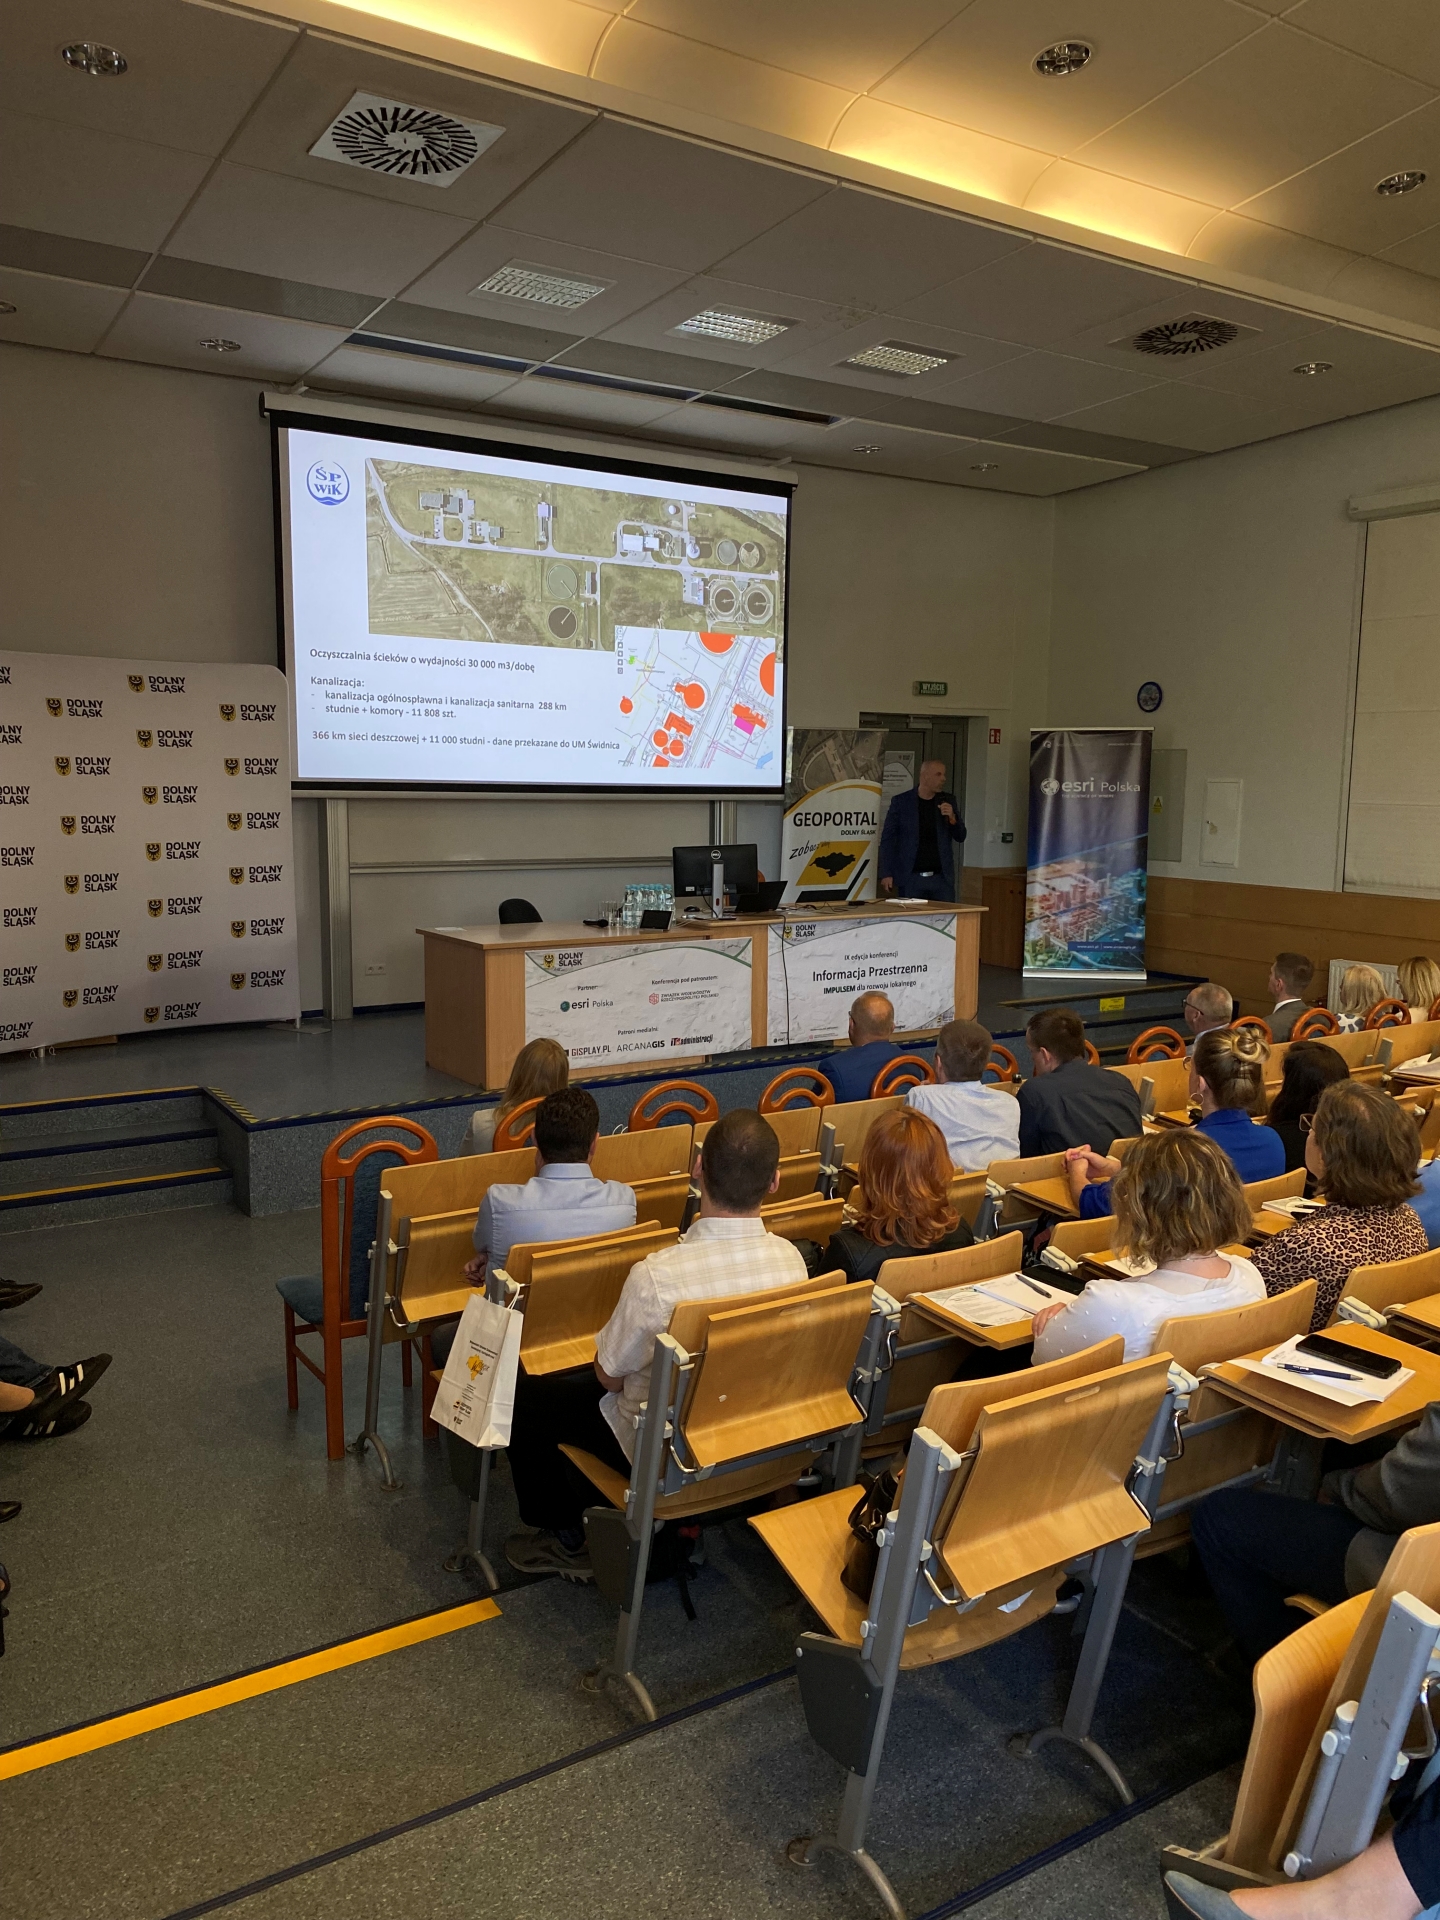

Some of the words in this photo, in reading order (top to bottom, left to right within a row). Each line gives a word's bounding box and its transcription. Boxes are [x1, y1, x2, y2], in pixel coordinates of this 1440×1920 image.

[310, 648, 371, 660] Oczyszczalnia
[374, 652, 408, 662] ścieków
[419, 656, 466, 667] wydajności
[468, 659, 478, 667] 30
[480, 660, 496, 668] 000
[498, 661, 535, 672] m3/dobę
[149, 676, 185, 684] DOLNY
[311, 676, 365, 688] Kanalizacja:
[150, 684, 185, 694] ŚLĄSK
[67, 699, 103, 708] DOLNY
[325, 690, 374, 702] kanalizacja
[378, 692, 442, 705] ogólnospławna
[450, 697, 494, 708] kanalizacja
[497, 700, 534, 709] sanitarna
[538, 702, 552, 710] 288
[555, 702, 566, 710] km
[68, 708, 102, 718] ŚLĄSK
[240, 704, 276, 713] DOLNY
[326, 704, 359, 714] studnie
[370, 706, 404, 718] komory
[424, 708, 440, 717] 808
[442, 710, 456, 718] szt.
[242, 713, 275, 722] ŚLĄSK
[157, 730, 193, 739] DOLNY
[159, 739, 193, 748] ŚLĄSK
[312, 731, 329, 740] 366
[332, 731, 346, 740] km
[348, 732, 368, 741] sieci
[370, 733, 419, 744] deszczowej
[442, 736, 457, 744] 000
[460, 736, 485, 745] studni
[492, 737, 512, 746] dane
[514, 738, 558, 750] przekazane
[560, 740, 570, 748] do
[588, 739, 620, 750] Świdnica
[75, 757, 111, 766] DOLNY
[245, 758, 279, 767] DOLNY
[77, 766, 110, 775] ŚLĄSK
[245, 767, 277, 776] ŚLĄSK
[1062, 777, 1094, 792] esri
[1101, 781, 1140, 792] Polska
[163, 786, 198, 794] DOLNY
[163, 794, 196, 804] ŚLĄSK
[81, 816, 116, 824] DOLNY
[247, 812, 280, 821] DOLNY
[793, 812, 877, 827] GEOPORTAL
[82, 824, 115, 834] ŚLĄSK
[248, 821, 279, 830] ŚLĄSK
[166, 842, 201, 850] DOLNY
[1, 847, 35, 856] DOLNY
[166, 850, 199, 860] ŚLĄSK
[1, 856, 34, 866] ŚLĄSK
[249, 865, 283, 874] DOLNY
[84, 873, 119, 882] DOLNY
[249, 874, 281, 883] ŚLĄSK
[85, 882, 117, 892] ŚLĄSK
[168, 897, 203, 906] DOLNY
[4, 907, 38, 916] DOLNY
[168, 905, 201, 914] ŚLĄSK
[4, 916, 36, 927] ŚLĄSK
[251, 918, 285, 927] DOLNY
[85, 931, 120, 940] DOLNY
[251, 927, 283, 936] ŚLĄSK
[796, 930, 815, 938] ŚLĄSK
[85, 939, 118, 949] ŚLĄSK
[168, 951, 203, 960] DOLNY
[559, 952, 584, 960] DOLNY
[851, 953, 868, 962] edycja
[870, 951, 898, 960] konferencji
[168, 959, 201, 968] ŚLĄSK
[558, 959, 582, 968] ŚLĄSK
[3, 966, 38, 976] DOLNY
[251, 970, 285, 979] DOLNY
[812, 968, 866, 982] Informacja
[869, 963, 928, 976] Przestrzenna
[3, 975, 35, 986] ŚLĄSK
[251, 978, 283, 987] ŚLĄSK
[83, 985, 119, 995] DOLNY
[824, 985, 856, 994] IMPULSEM
[856, 983, 866, 991] dla
[866, 982, 888, 990] rozwoju
[890, 980, 916, 990] lokalnego
[83, 994, 115, 1004] ŚLĄSK
[572, 998, 590, 1009] esri
[592, 1000, 614, 1008] Polska
[165, 1002, 201, 1012] DOLNY
[164, 1010, 197, 1021] ŚLĄSK
[572, 1044, 612, 1056] GISPLAY.PL
[616, 1040, 665, 1052] ARCANAGIS
